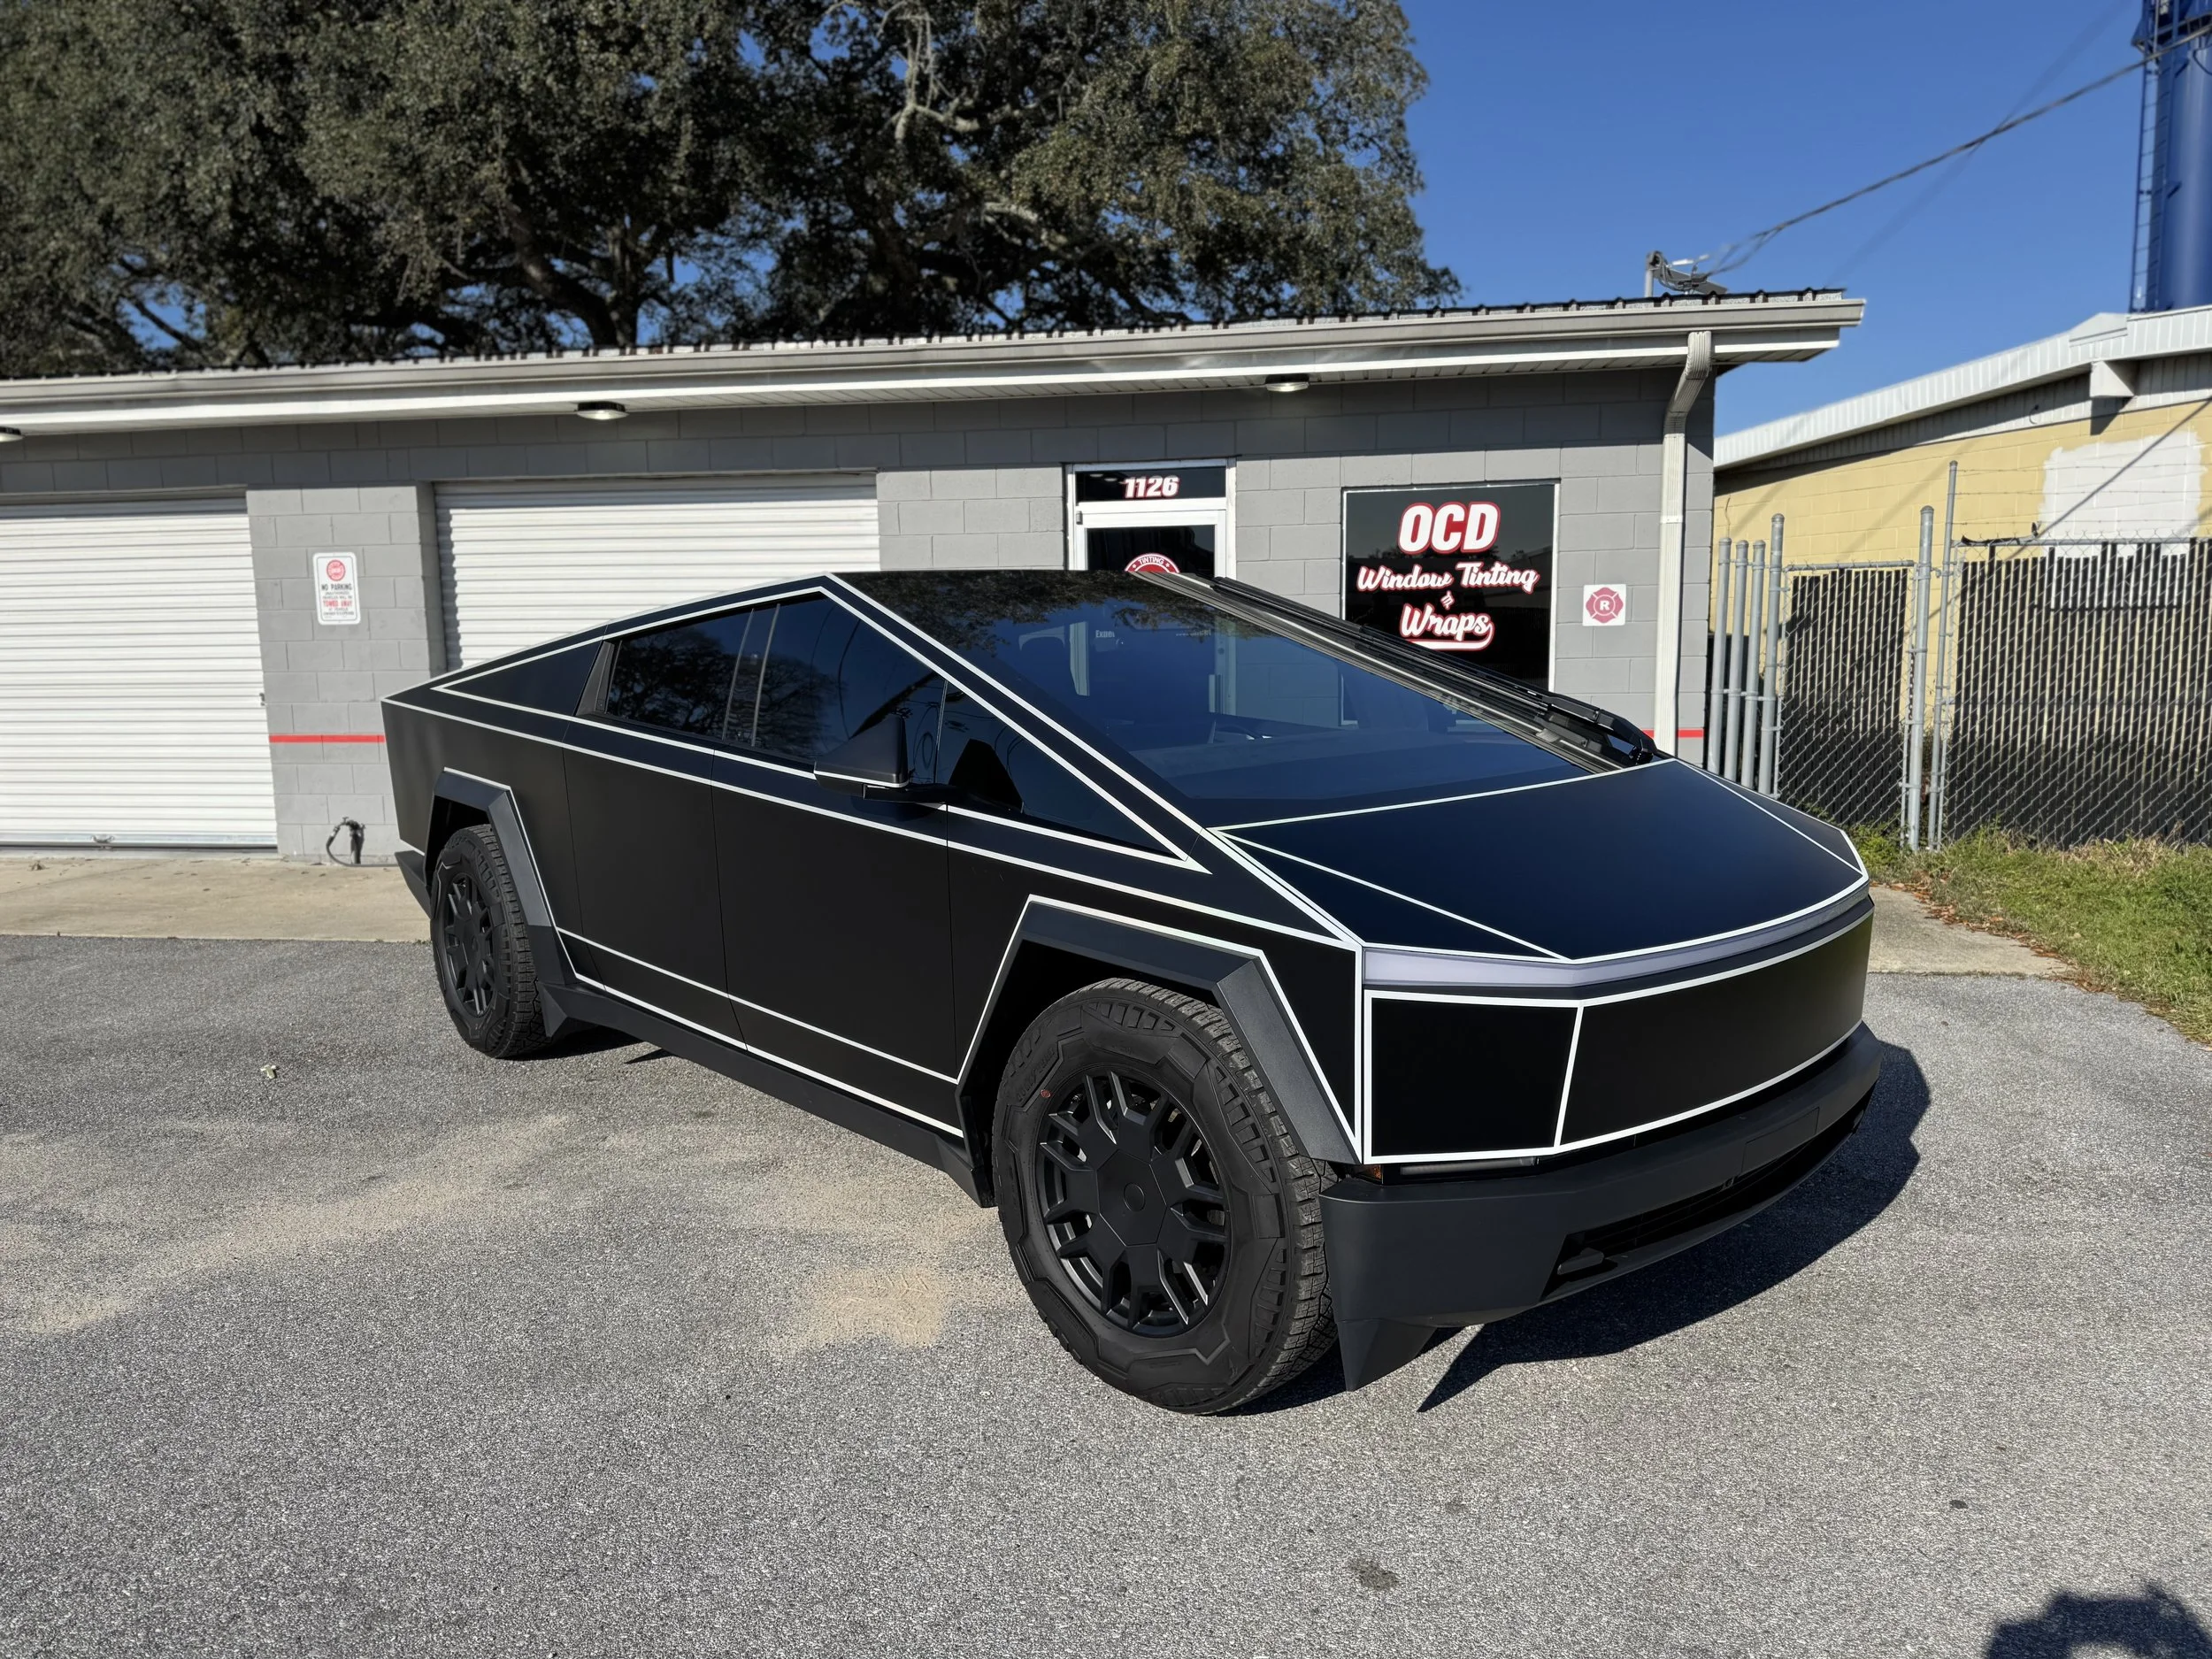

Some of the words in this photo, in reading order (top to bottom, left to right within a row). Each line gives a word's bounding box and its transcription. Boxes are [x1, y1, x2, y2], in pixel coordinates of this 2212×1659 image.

[1124, 475, 1179, 499] 1126
[1398, 502, 1501, 555] OCD
[1138, 556, 1165, 565] TINTING
[1357, 565, 1454, 591] Window
[1455, 561, 1540, 595] Tinting
[1599, 600, 1610, 611] R
[1400, 603, 1494, 642] Wraps
